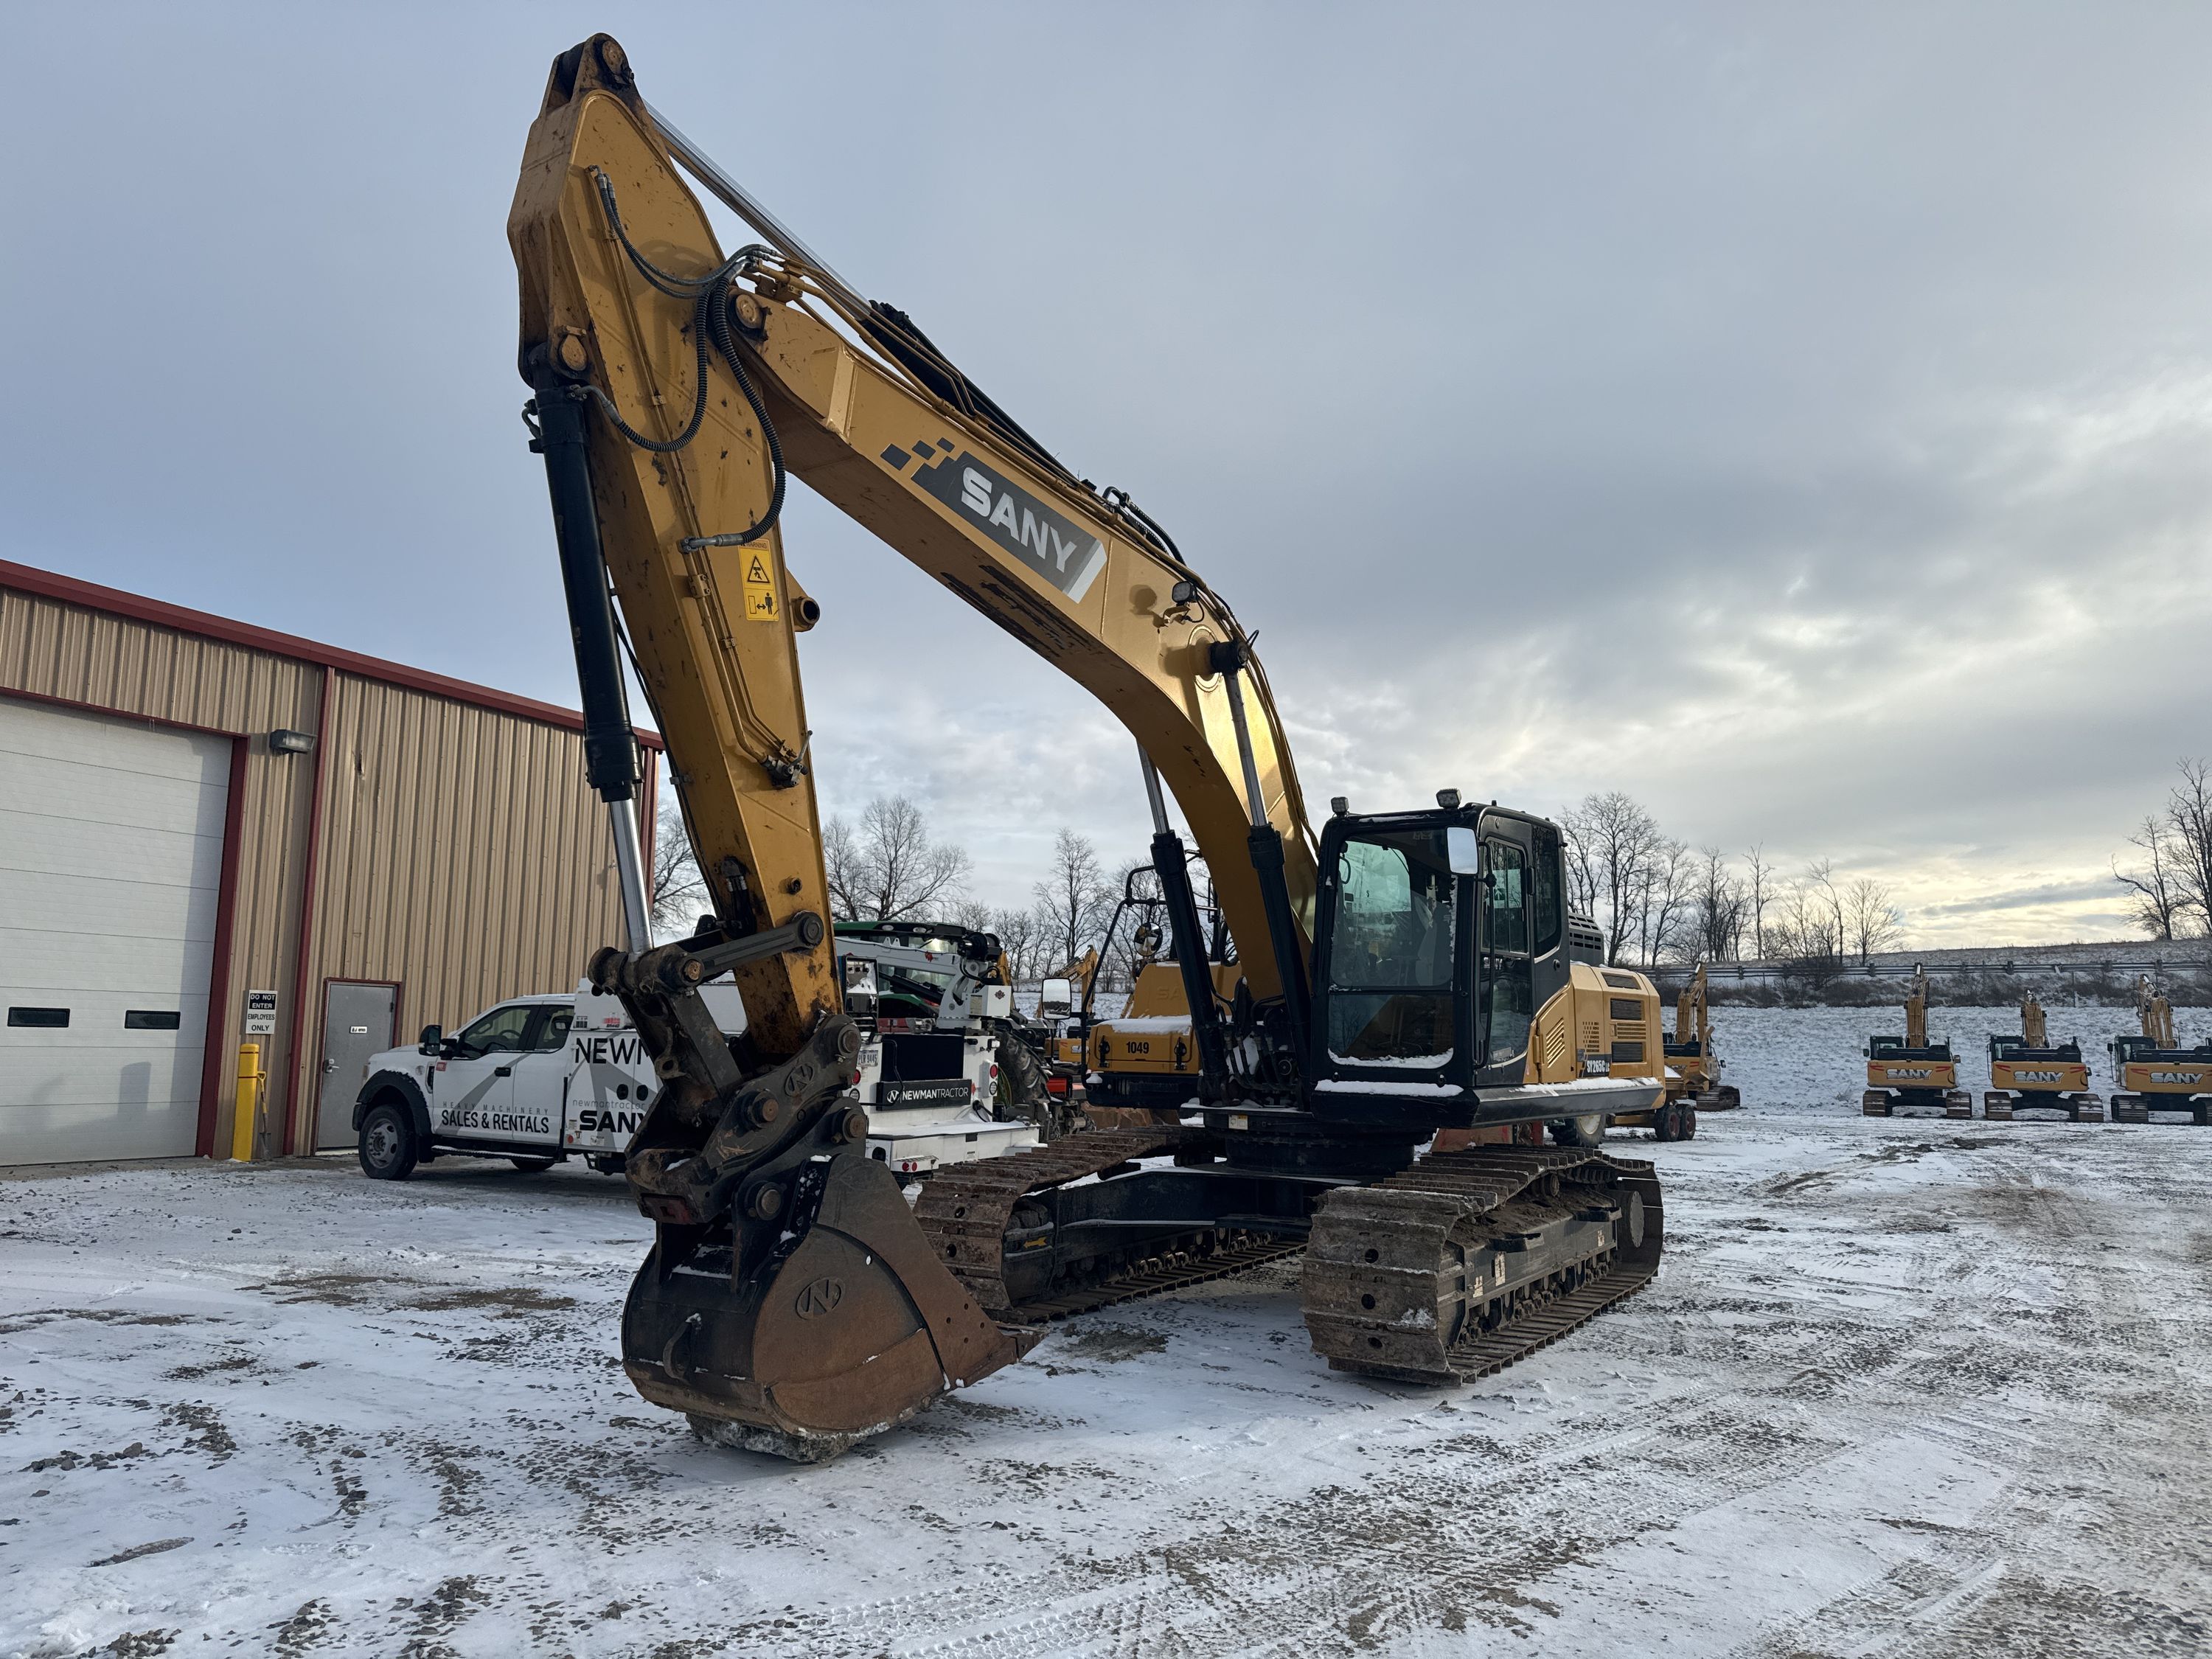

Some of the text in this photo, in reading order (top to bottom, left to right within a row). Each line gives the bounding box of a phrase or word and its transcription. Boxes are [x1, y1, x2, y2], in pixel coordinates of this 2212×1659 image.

[961, 467, 1077, 573] SANY
[1126, 1040, 1150, 1054] 1049
[1587, 1060, 1605, 1073] SY265C
[1886, 1068, 1933, 1079] SANY
[2014, 1071, 2065, 1083] SANY
[2150, 1071, 2205, 1085] SANY
[902, 1088, 969, 1101] NEWMANTRACTOR
[442, 1101, 549, 1115] HEAVY MACHINERY
[442, 1109, 479, 1128] SALES
[481, 1113, 490, 1129] &
[493, 1113, 549, 1133] RENTALS
